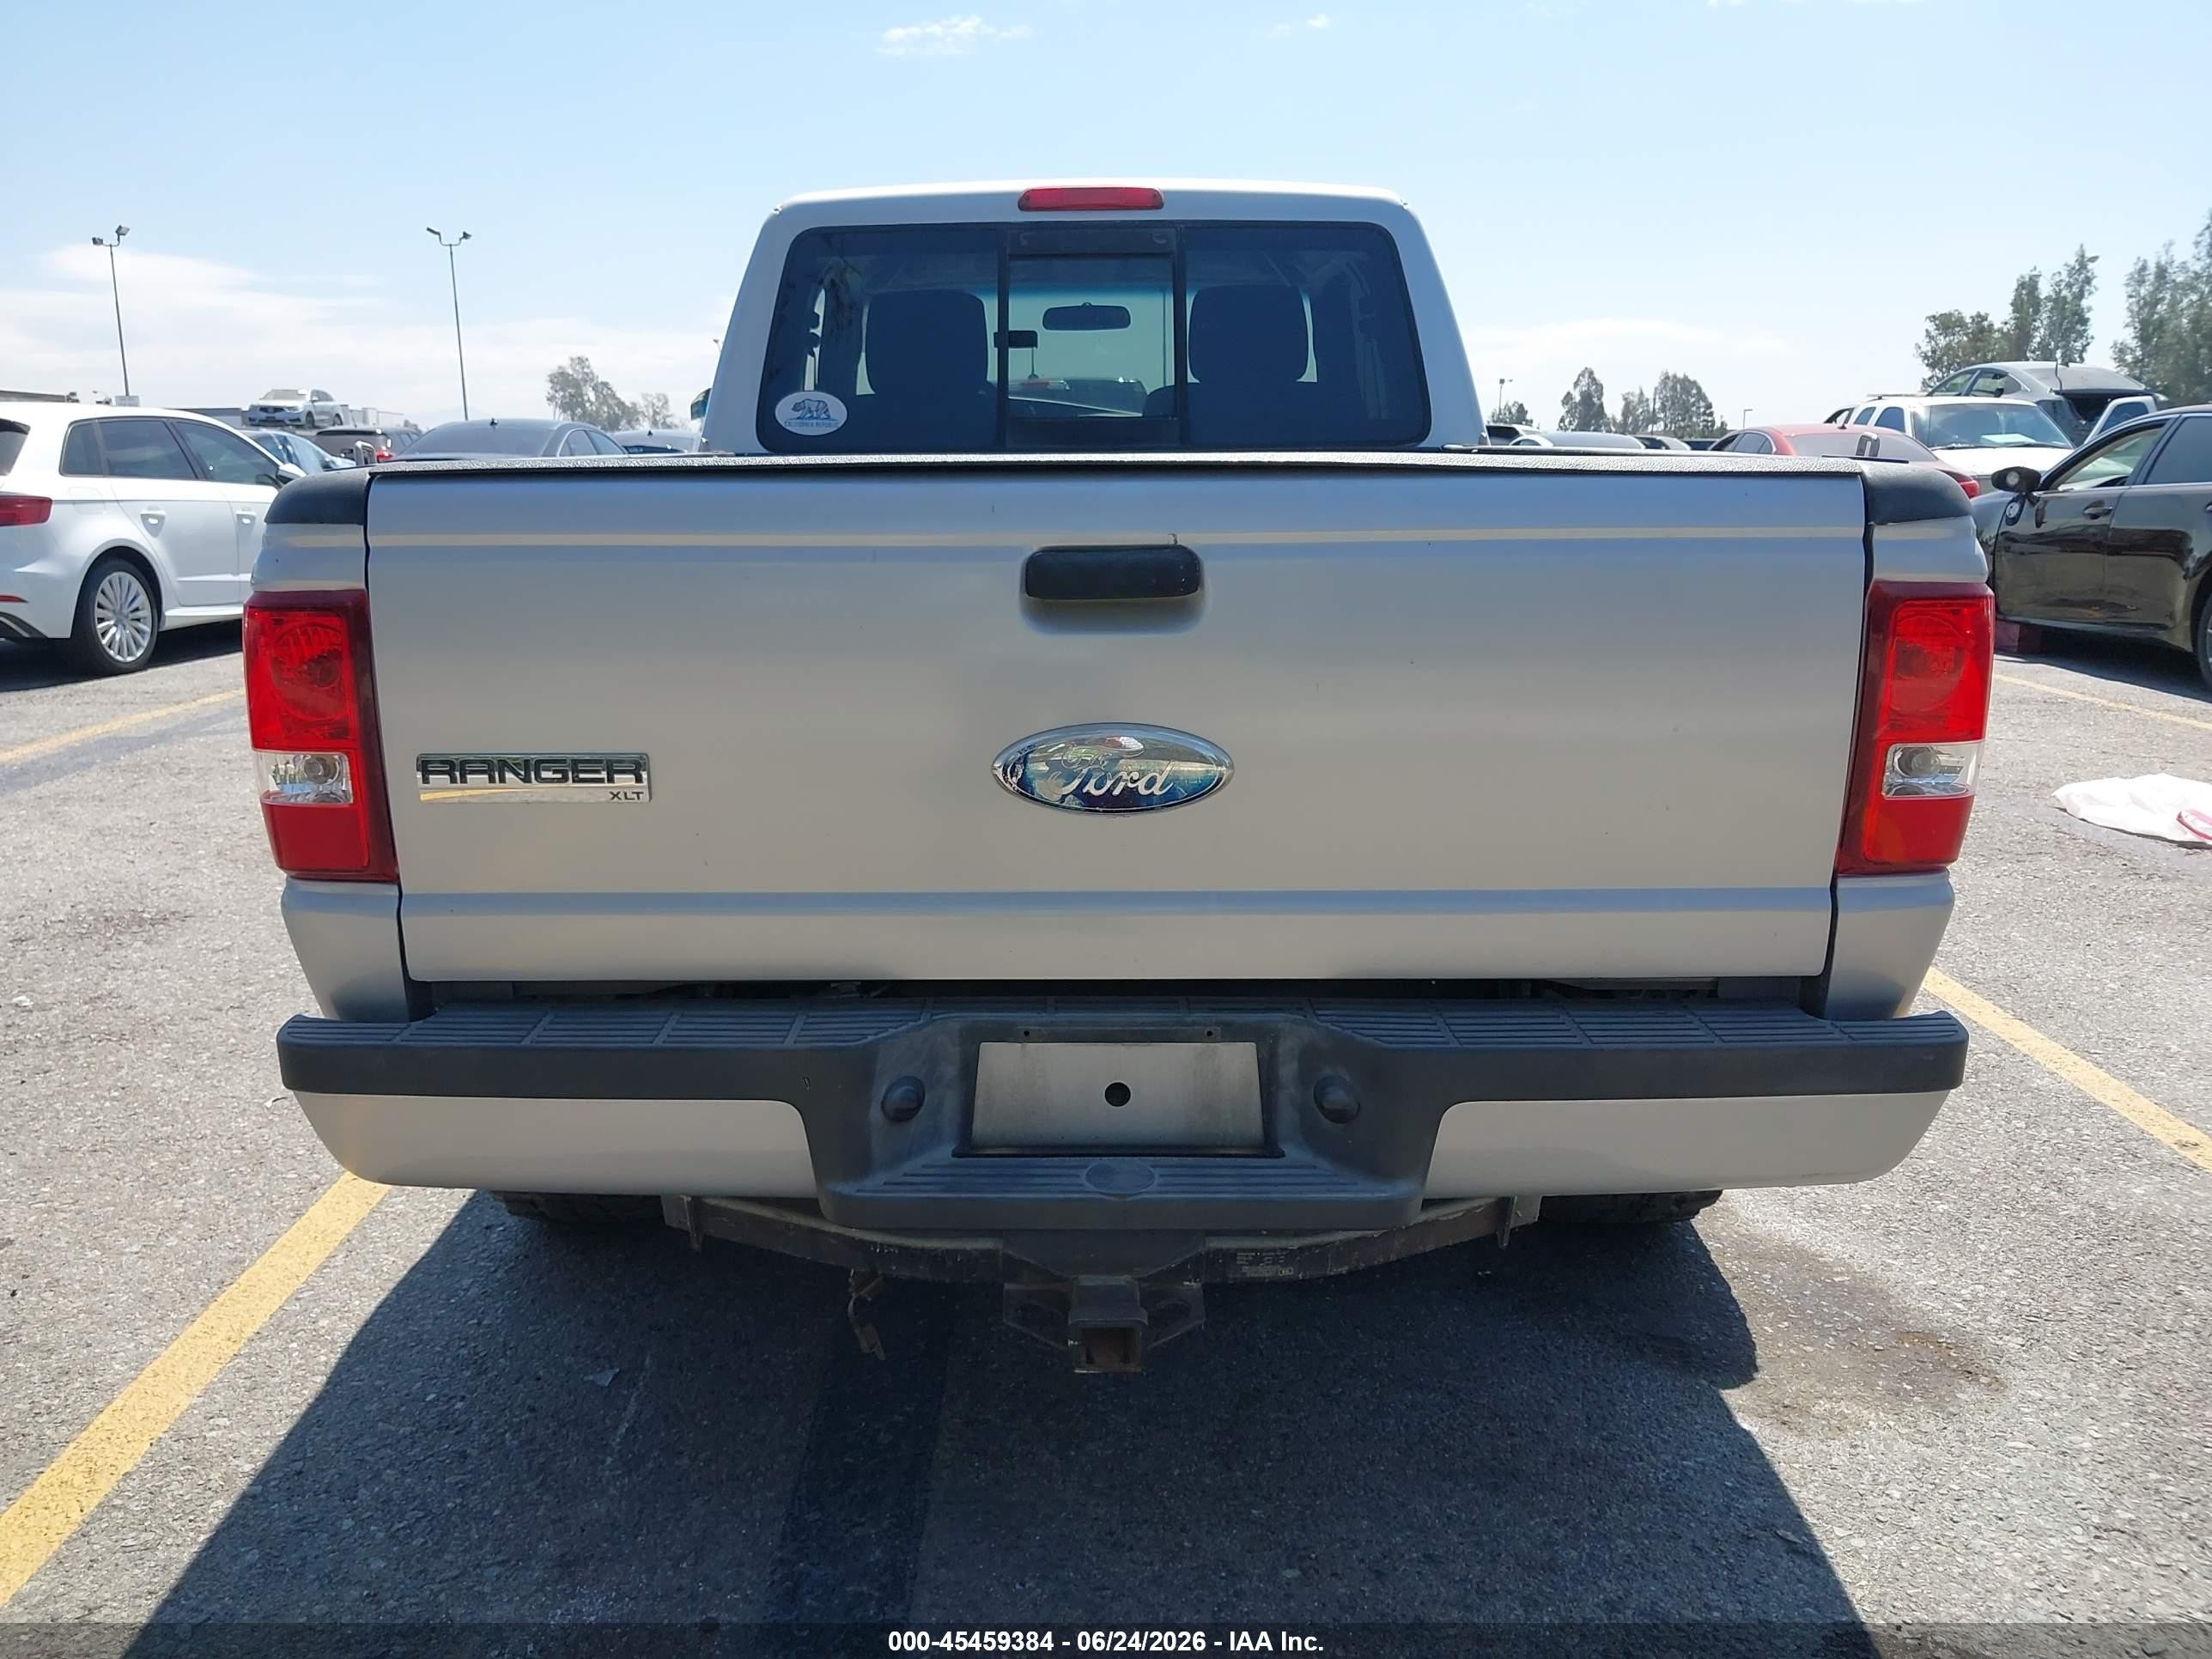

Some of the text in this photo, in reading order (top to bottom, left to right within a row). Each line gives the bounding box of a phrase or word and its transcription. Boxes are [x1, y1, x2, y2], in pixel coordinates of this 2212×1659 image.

[421, 757, 644, 785] RANGER
[1048, 752, 1175, 797] Ford
[609, 790, 644, 801] XLT
